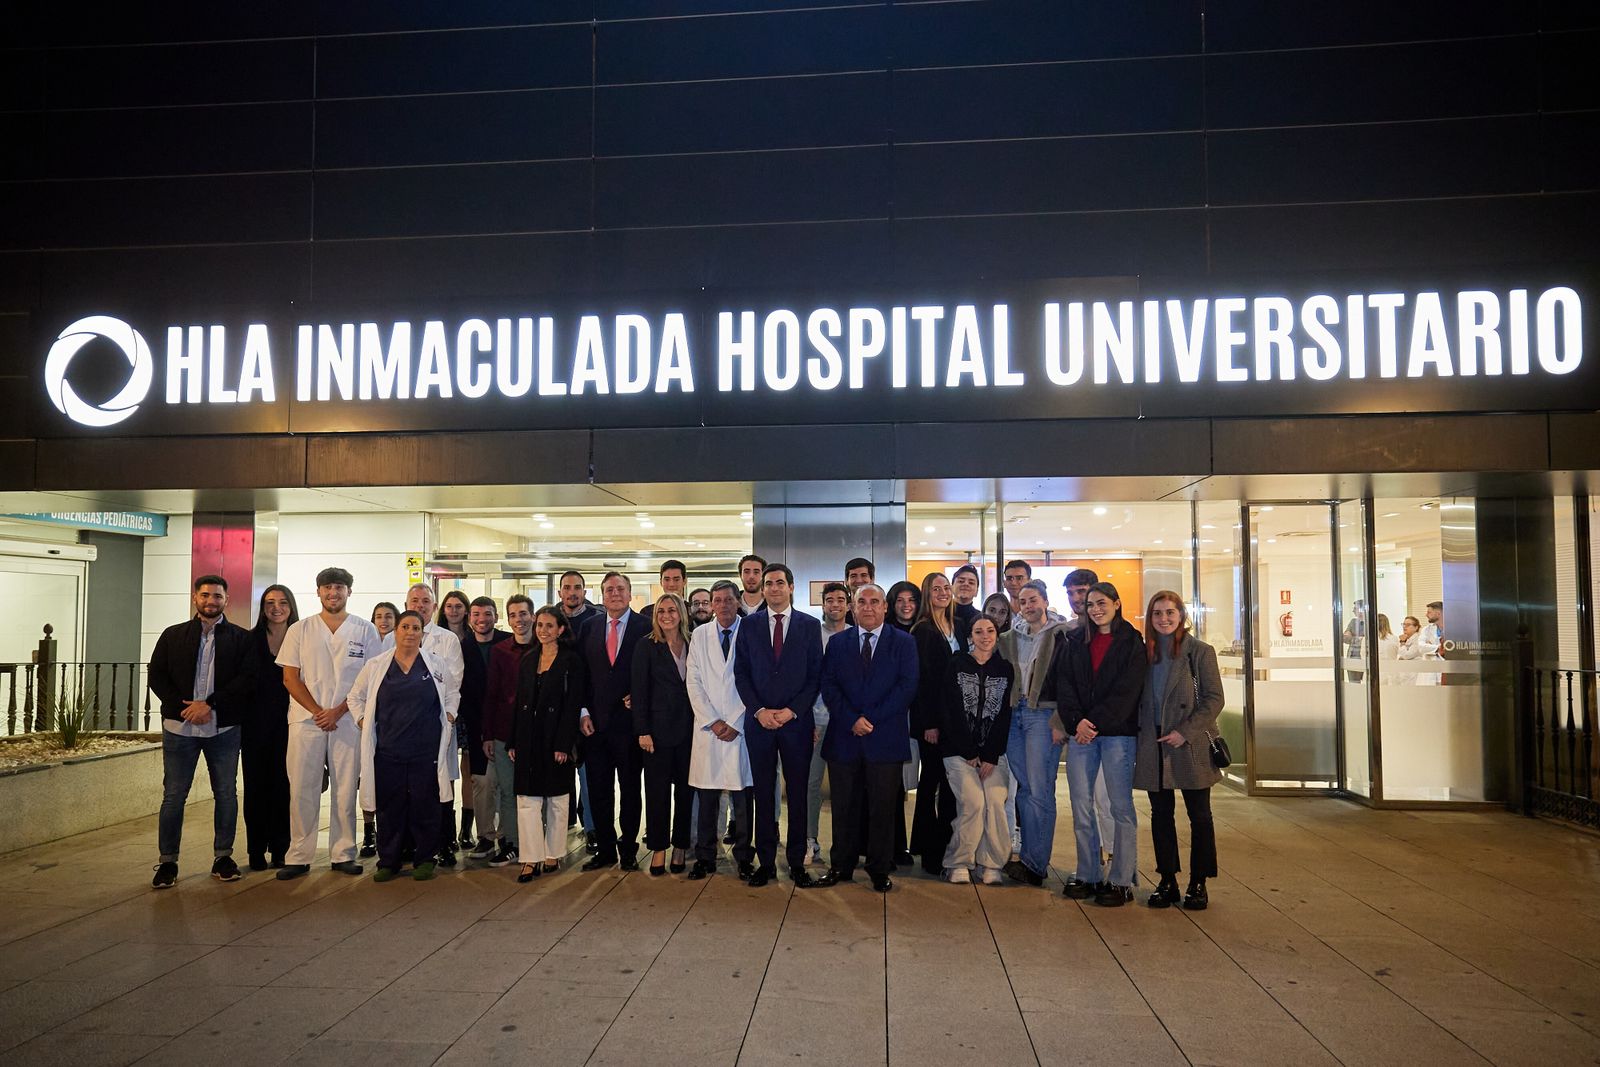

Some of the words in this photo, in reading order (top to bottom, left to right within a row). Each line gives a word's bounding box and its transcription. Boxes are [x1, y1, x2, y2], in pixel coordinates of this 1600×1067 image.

[165, 323, 277, 405] HLA
[296, 312, 695, 402] INMACULADA
[718, 304, 1025, 392] HOSPITAL
[1044, 286, 1584, 387] UNIVERSITARIO
[102, 511, 153, 531] PEDIÁTRICAS
